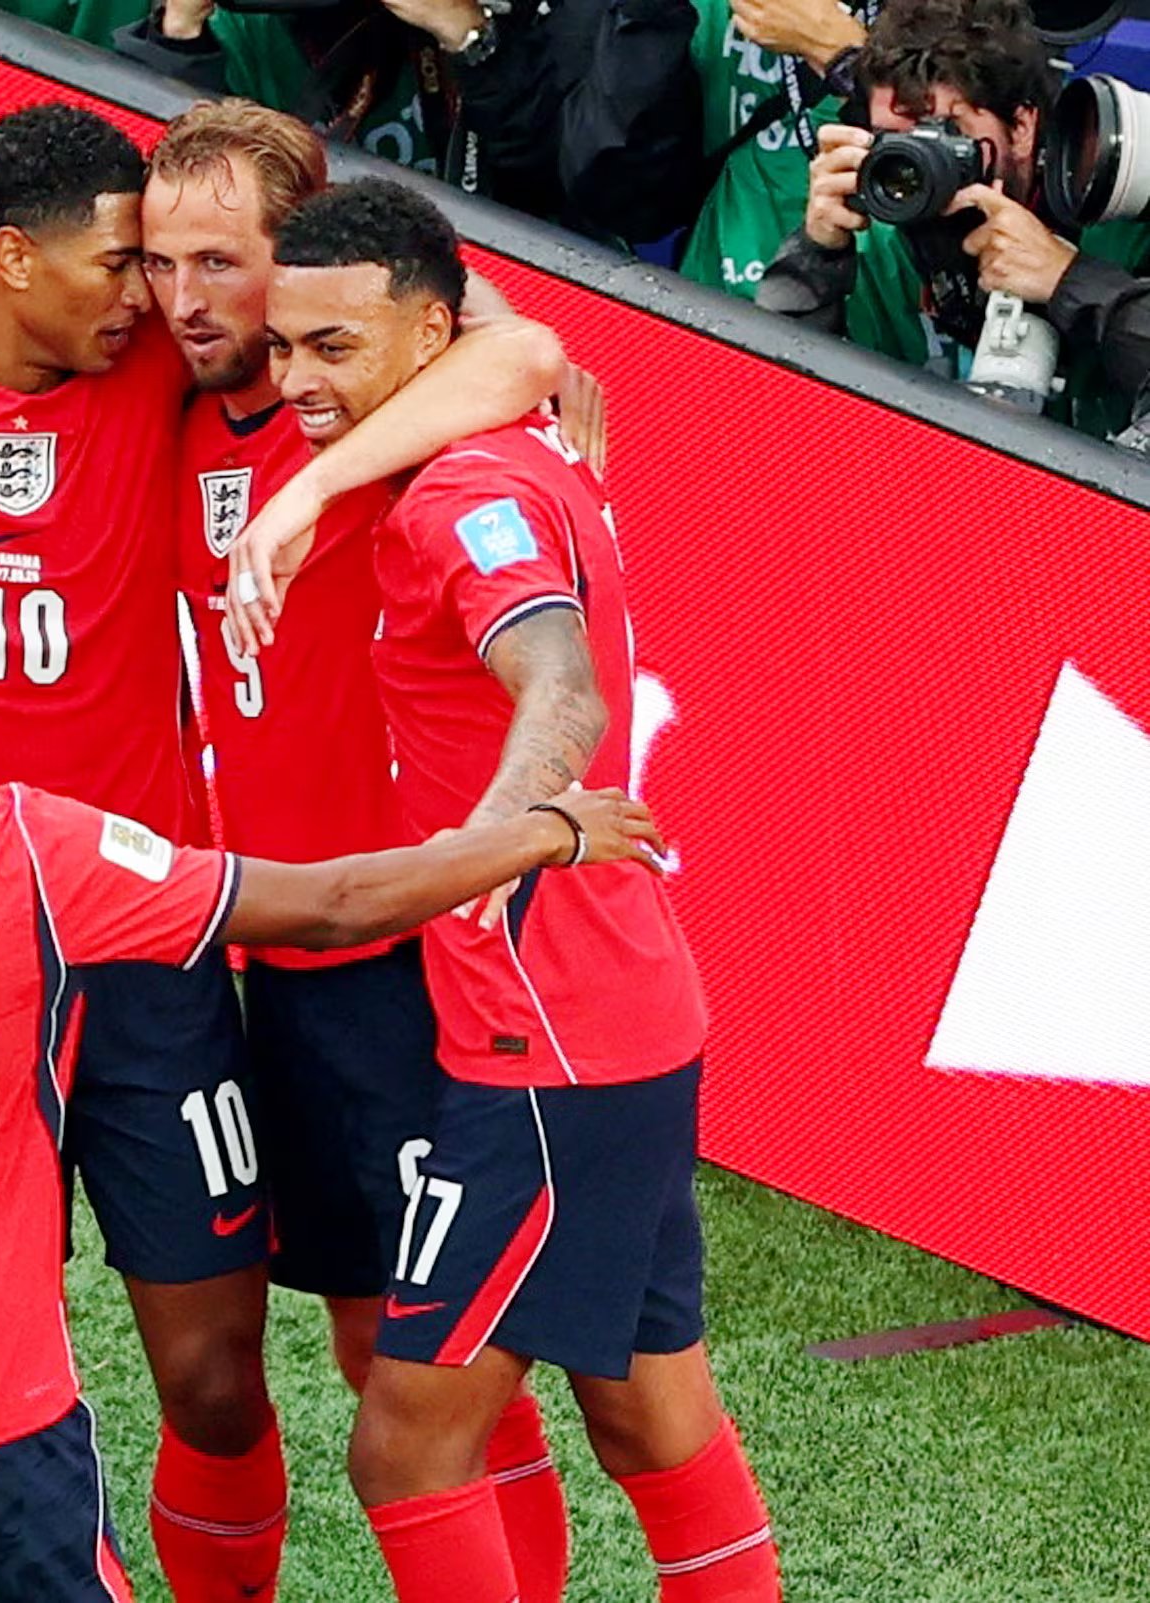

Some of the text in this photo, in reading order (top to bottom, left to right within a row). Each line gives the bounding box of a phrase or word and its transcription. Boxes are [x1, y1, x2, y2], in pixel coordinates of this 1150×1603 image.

[461, 130, 479, 193] Canon
[180, 1079, 258, 1198] 10
[394, 1174, 464, 1286] 17
